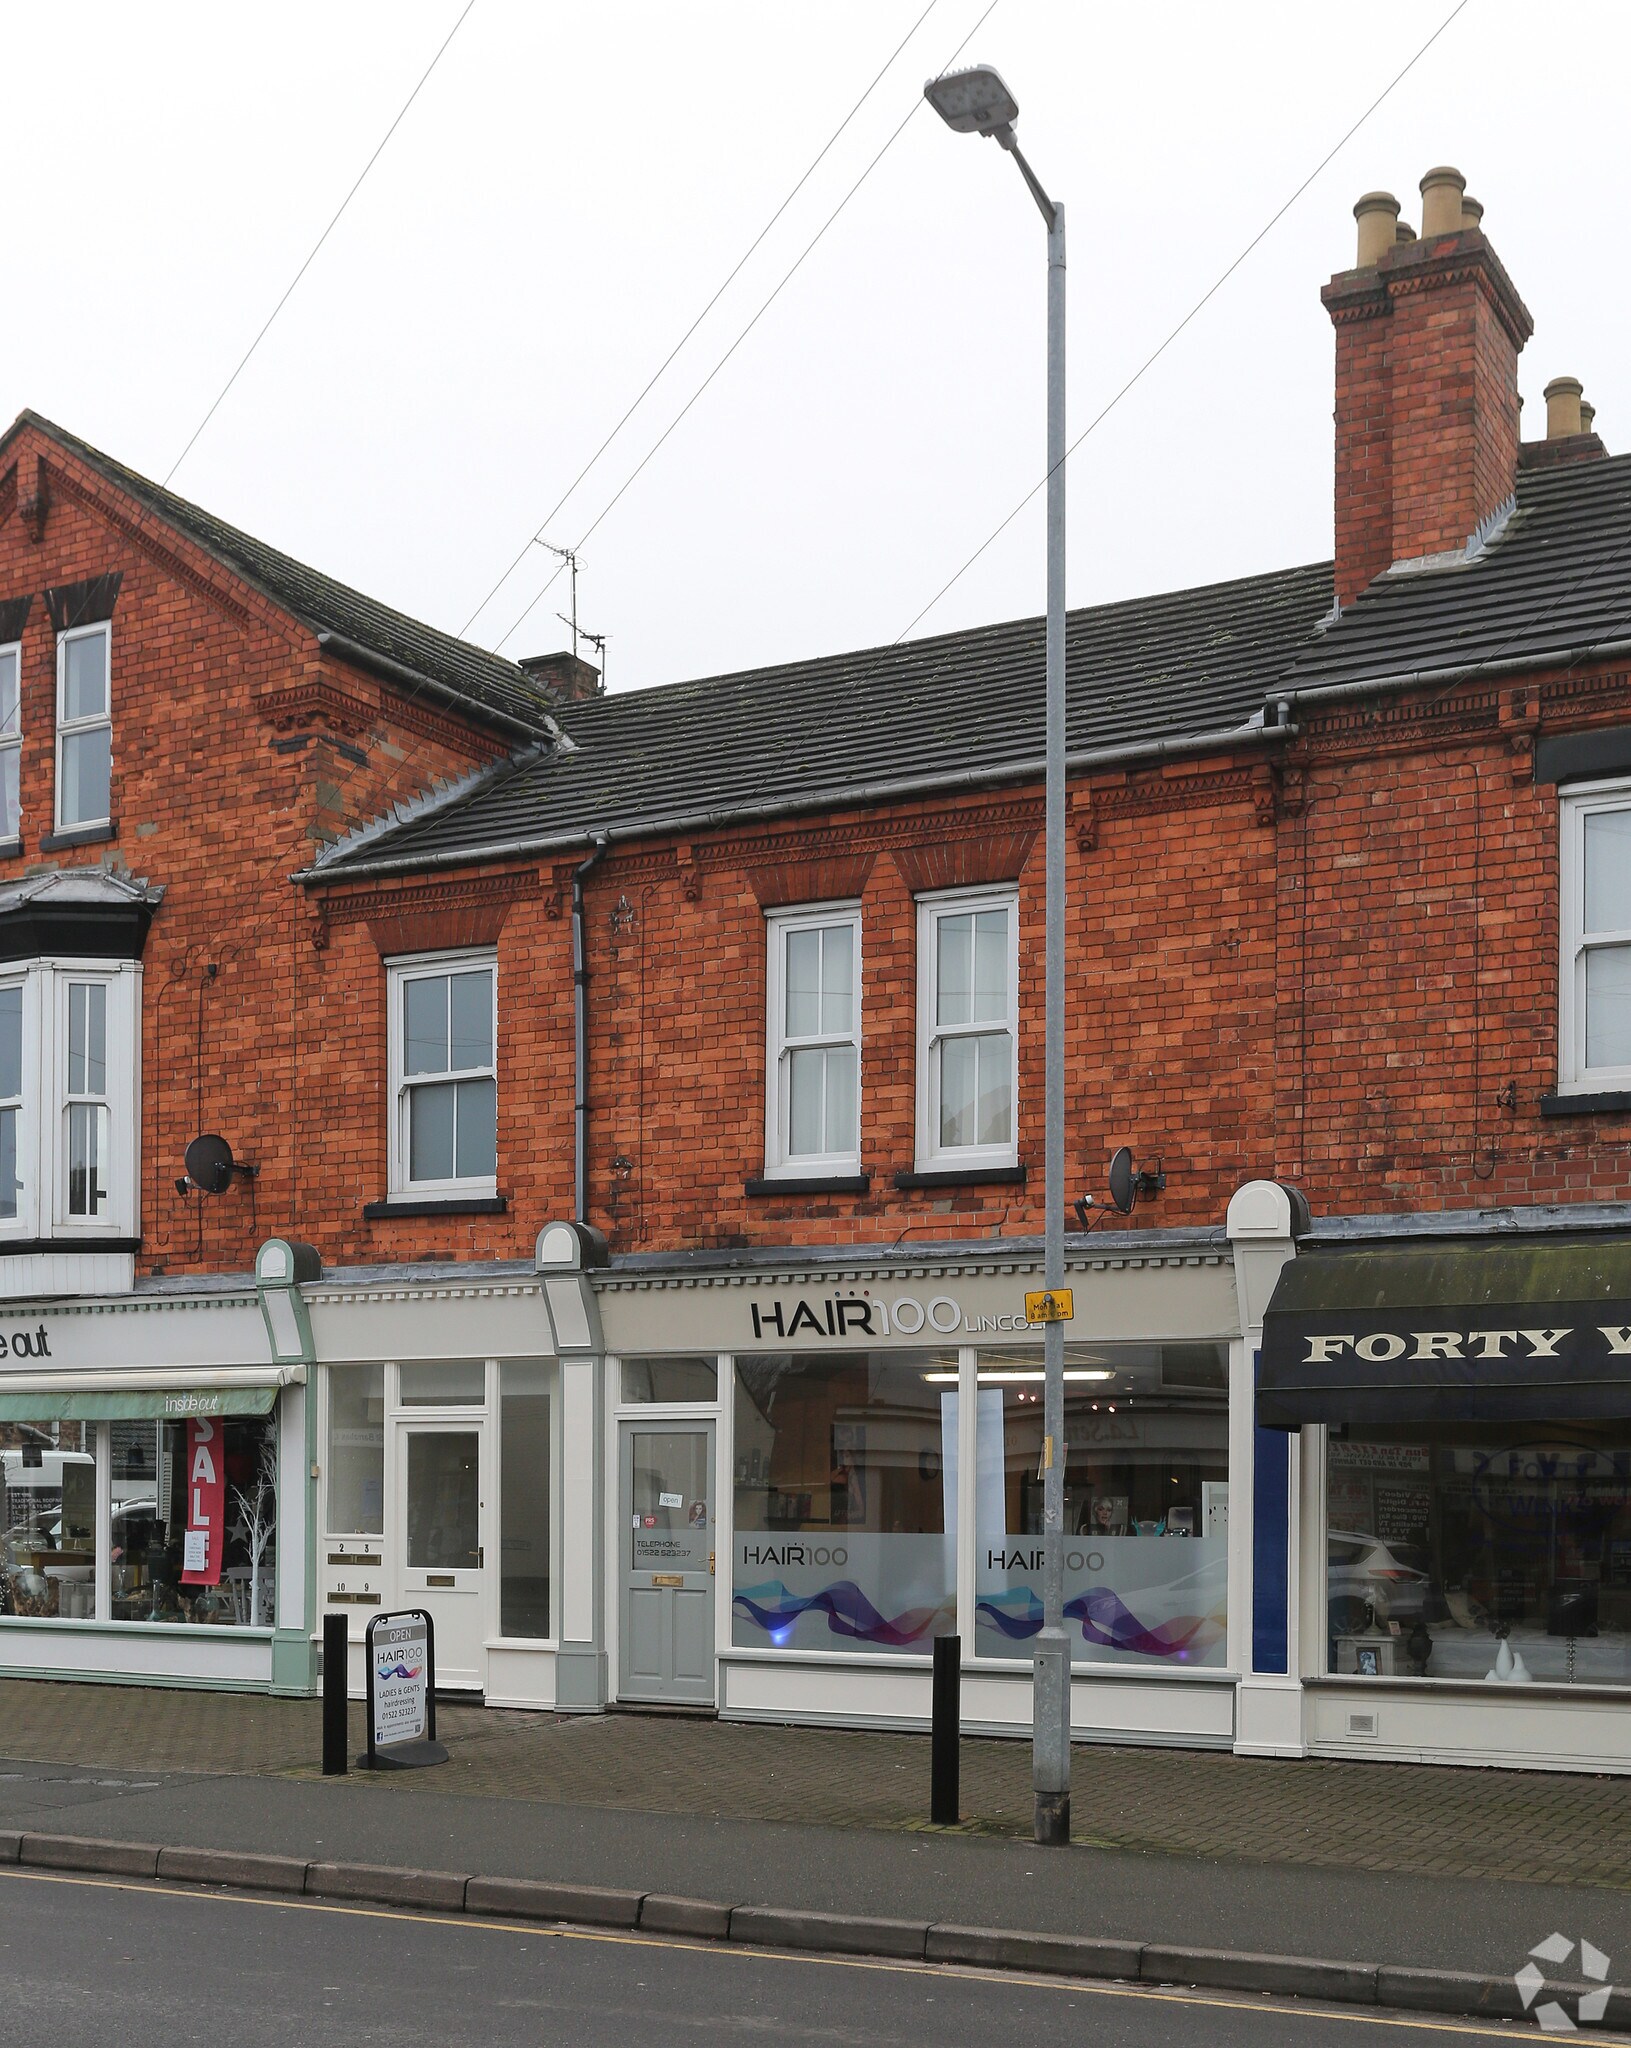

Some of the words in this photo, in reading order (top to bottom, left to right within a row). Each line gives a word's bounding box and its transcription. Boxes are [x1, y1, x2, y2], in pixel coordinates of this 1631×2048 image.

[1037, 1311, 1048, 1319] am
[965, 1314, 1046, 1332] LINCOL
[11, 1324, 51, 1358] out
[1301, 1328, 1575, 1362] FORTY
[165, 1394, 198, 1412] inside
[662, 1496, 679, 1504] open
[339, 1543, 345, 1553] 2
[364, 1544, 370, 1554] 3
[636, 1540, 681, 1548] TELEPHONE
[660, 1549, 691, 1557] 523237
[337, 1582, 346, 1592] 10
[364, 1582, 370, 1592] 9
[389, 1628, 412, 1642] OPEN
[379, 1688, 397, 1699] LADIES
[403, 1683, 421, 1695] GENTS
[384, 1697, 415, 1709] hairdressing
[381, 1710, 398, 1721] 01522
